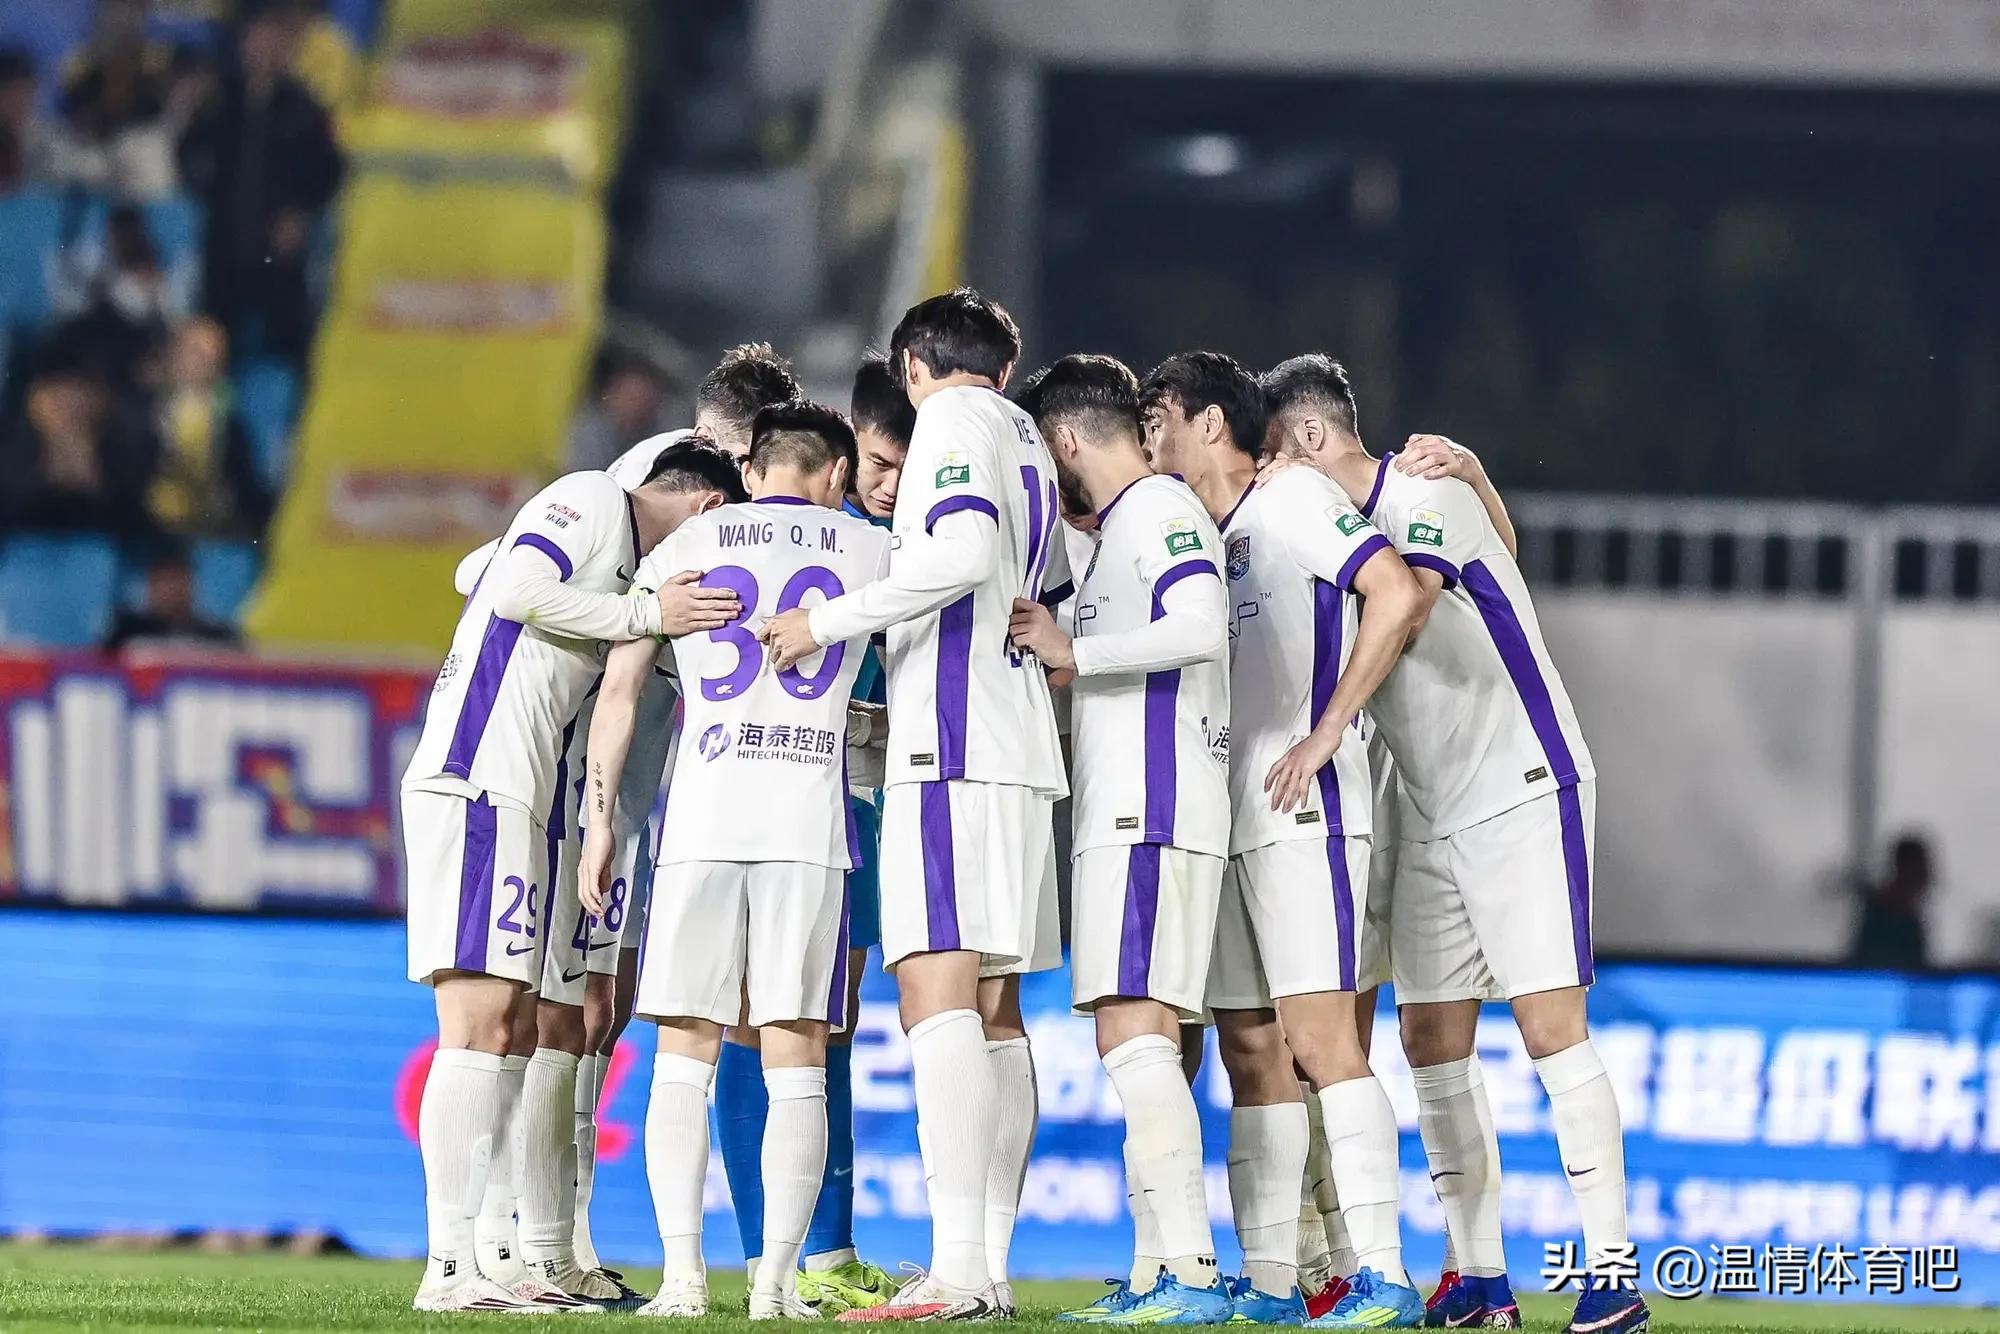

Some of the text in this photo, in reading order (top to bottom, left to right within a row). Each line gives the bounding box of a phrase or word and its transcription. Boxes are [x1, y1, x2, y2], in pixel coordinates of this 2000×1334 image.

[719, 522, 773, 548] WANG
[699, 565, 846, 702] 30
[737, 722, 836, 756] 海泰控股
[737, 749, 780, 760] HITECH
[497, 875, 537, 938] 29
